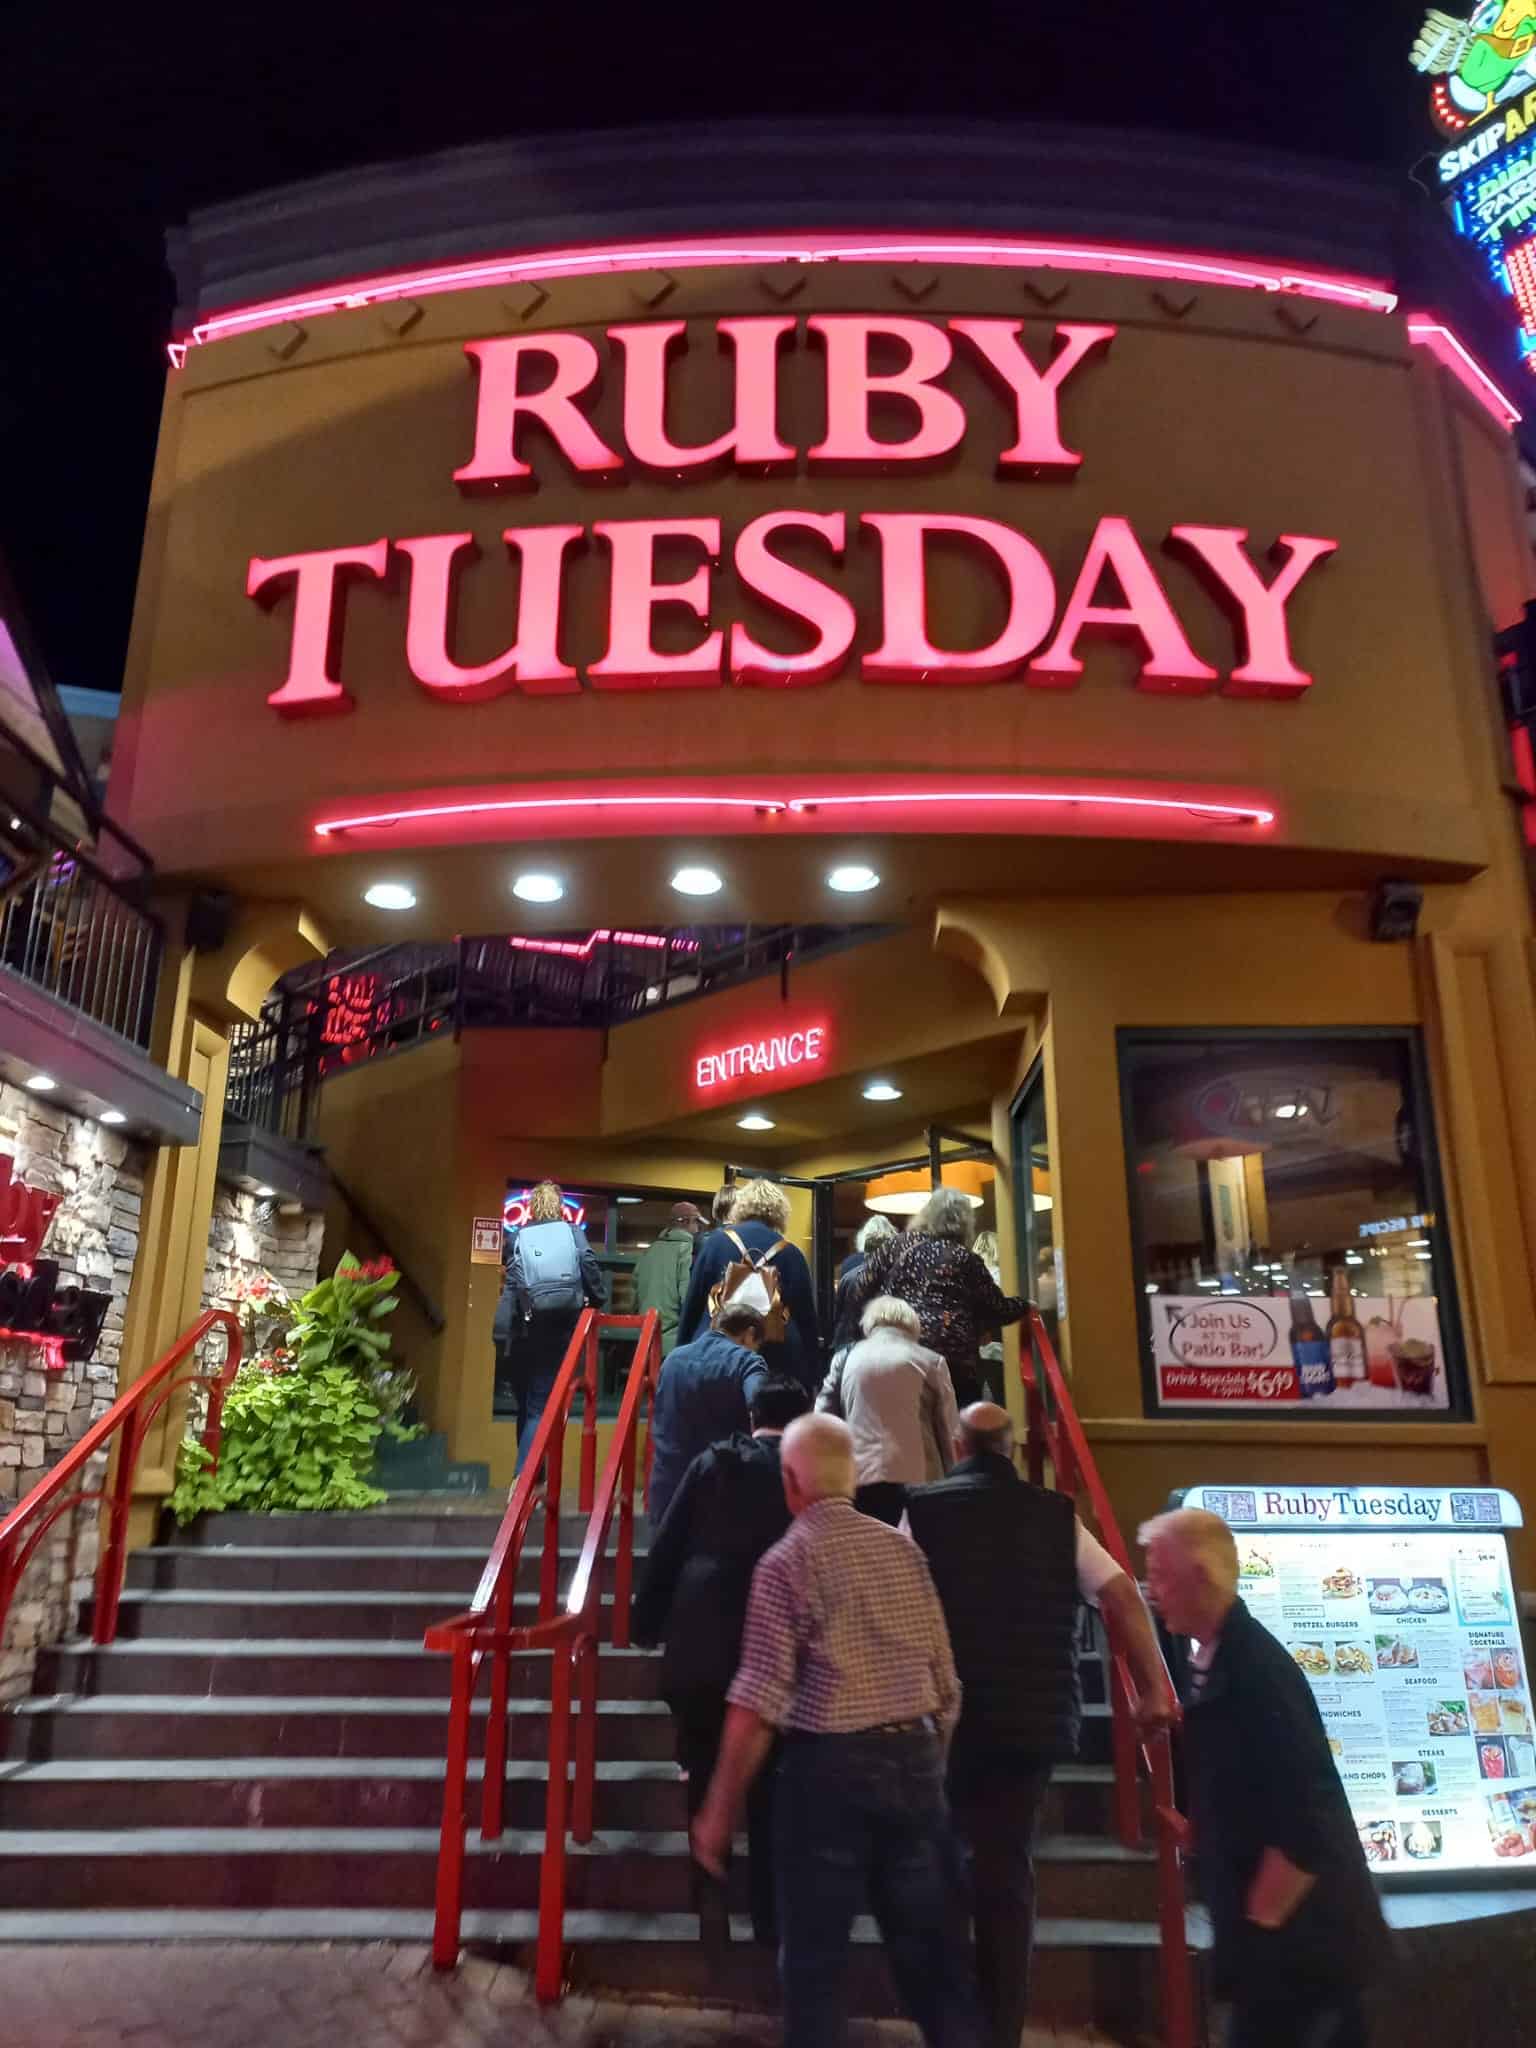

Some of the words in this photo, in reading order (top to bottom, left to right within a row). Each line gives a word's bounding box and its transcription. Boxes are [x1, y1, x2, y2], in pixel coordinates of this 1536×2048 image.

[453, 315, 1116, 485] RUBY
[247, 511, 1338, 712] TUESDAY
[696, 1026, 824, 1087] ENTRANCE
[1191, 1312, 1225, 1328] Join
[1230, 1314, 1251, 1328] Us
[1182, 1342, 1225, 1357] Patio
[1396, 1616, 1427, 1625] CHICKEN
[1468, 1631, 1505, 1639] SIGNATURE
[1469, 1638, 1506, 1646] COCKTAILS
[1404, 1677, 1438, 1686] SEAFOOD
[1418, 1749, 1445, 1757] STEAKS
[1361, 1771, 1386, 1780] CHOPS
[1421, 1808, 1458, 1817] DESSERTS
